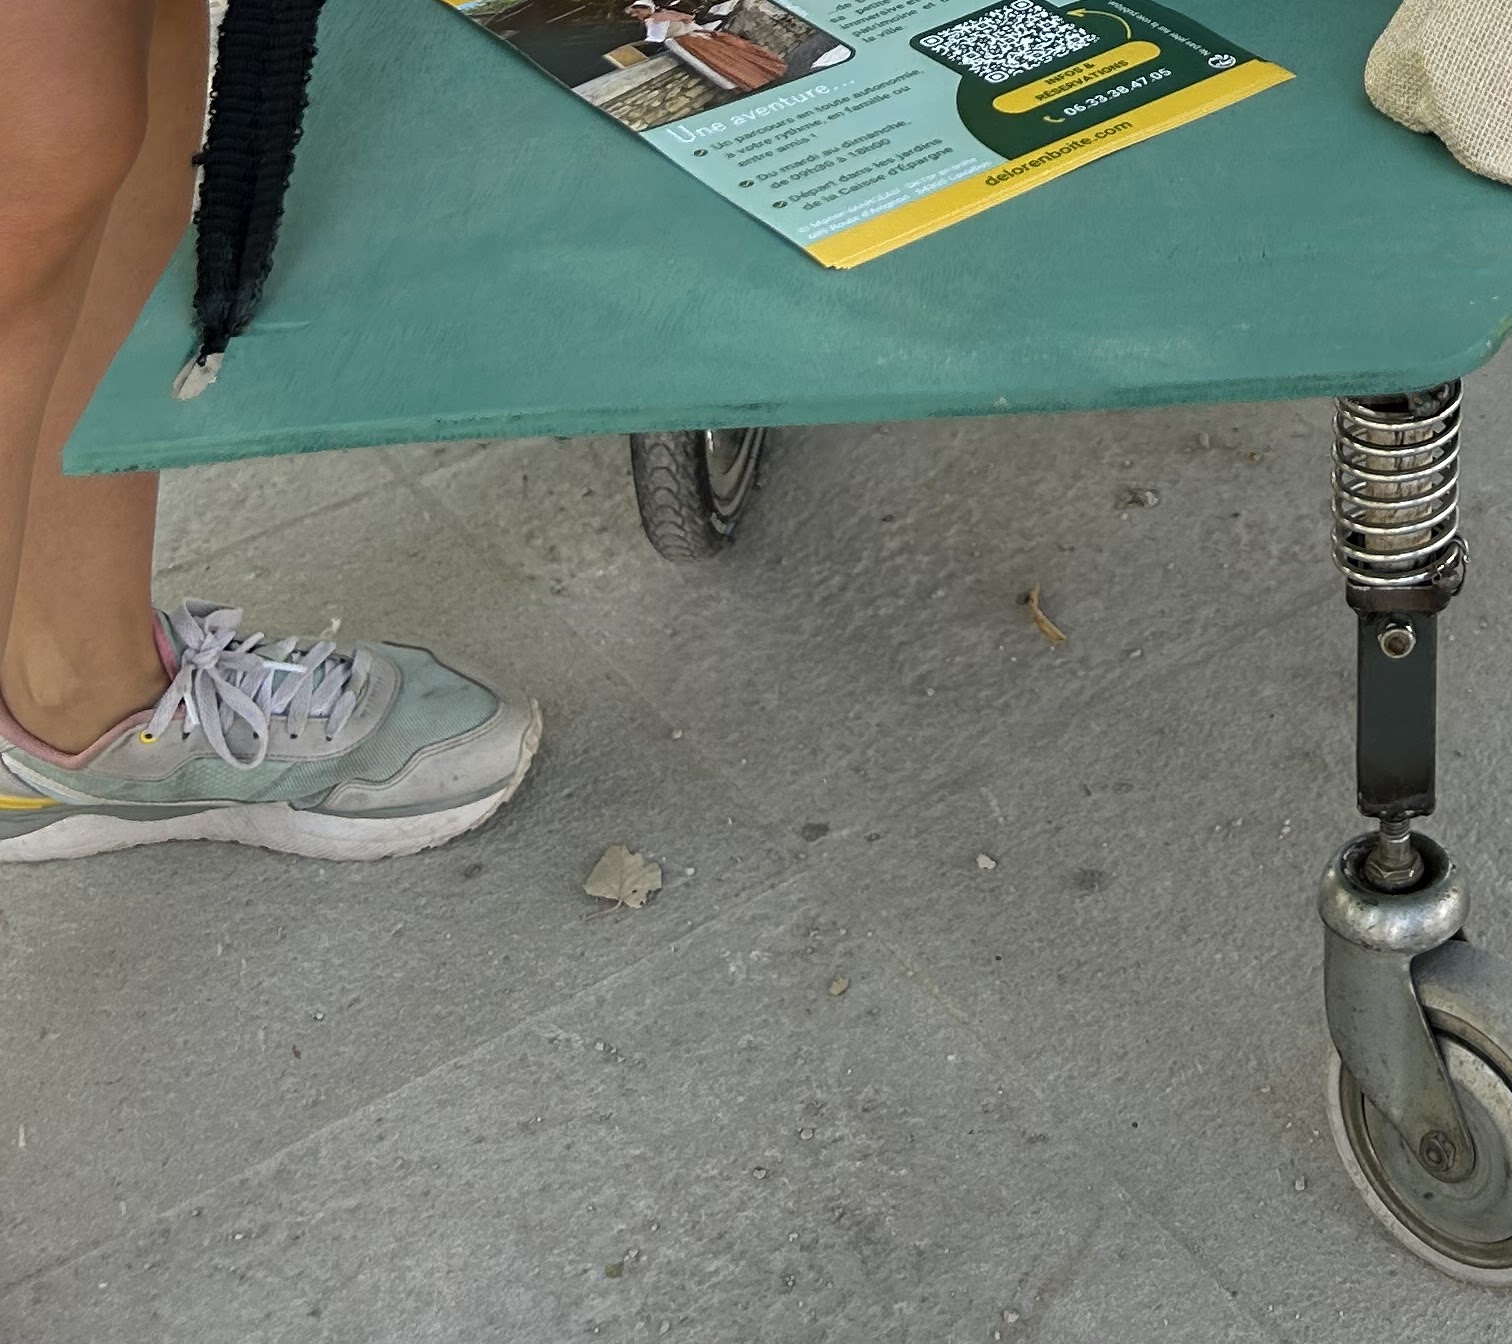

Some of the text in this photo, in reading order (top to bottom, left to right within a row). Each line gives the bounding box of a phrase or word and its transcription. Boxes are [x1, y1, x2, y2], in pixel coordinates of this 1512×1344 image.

[1045, 67, 1085, 85] INFOS
[1063, 67, 1171, 116] 06.33.38.47.05
[666, 124, 727, 143] Une
